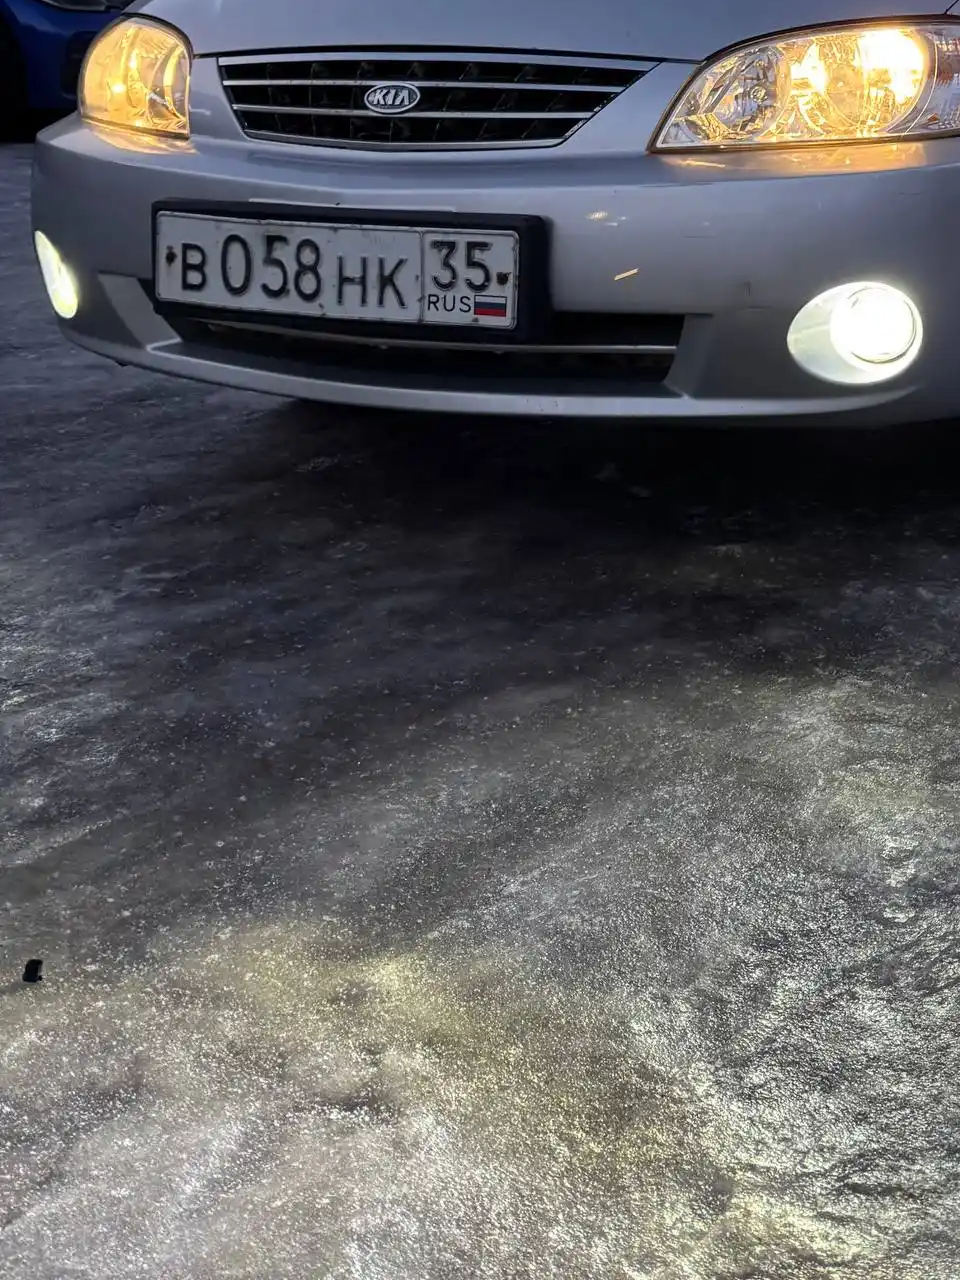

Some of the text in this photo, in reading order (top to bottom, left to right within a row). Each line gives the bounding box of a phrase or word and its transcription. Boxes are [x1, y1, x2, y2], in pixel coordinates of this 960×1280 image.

[373, 87, 410, 105] KIA
[429, 240, 494, 293] 35
[427, 293, 472, 314] RUS
